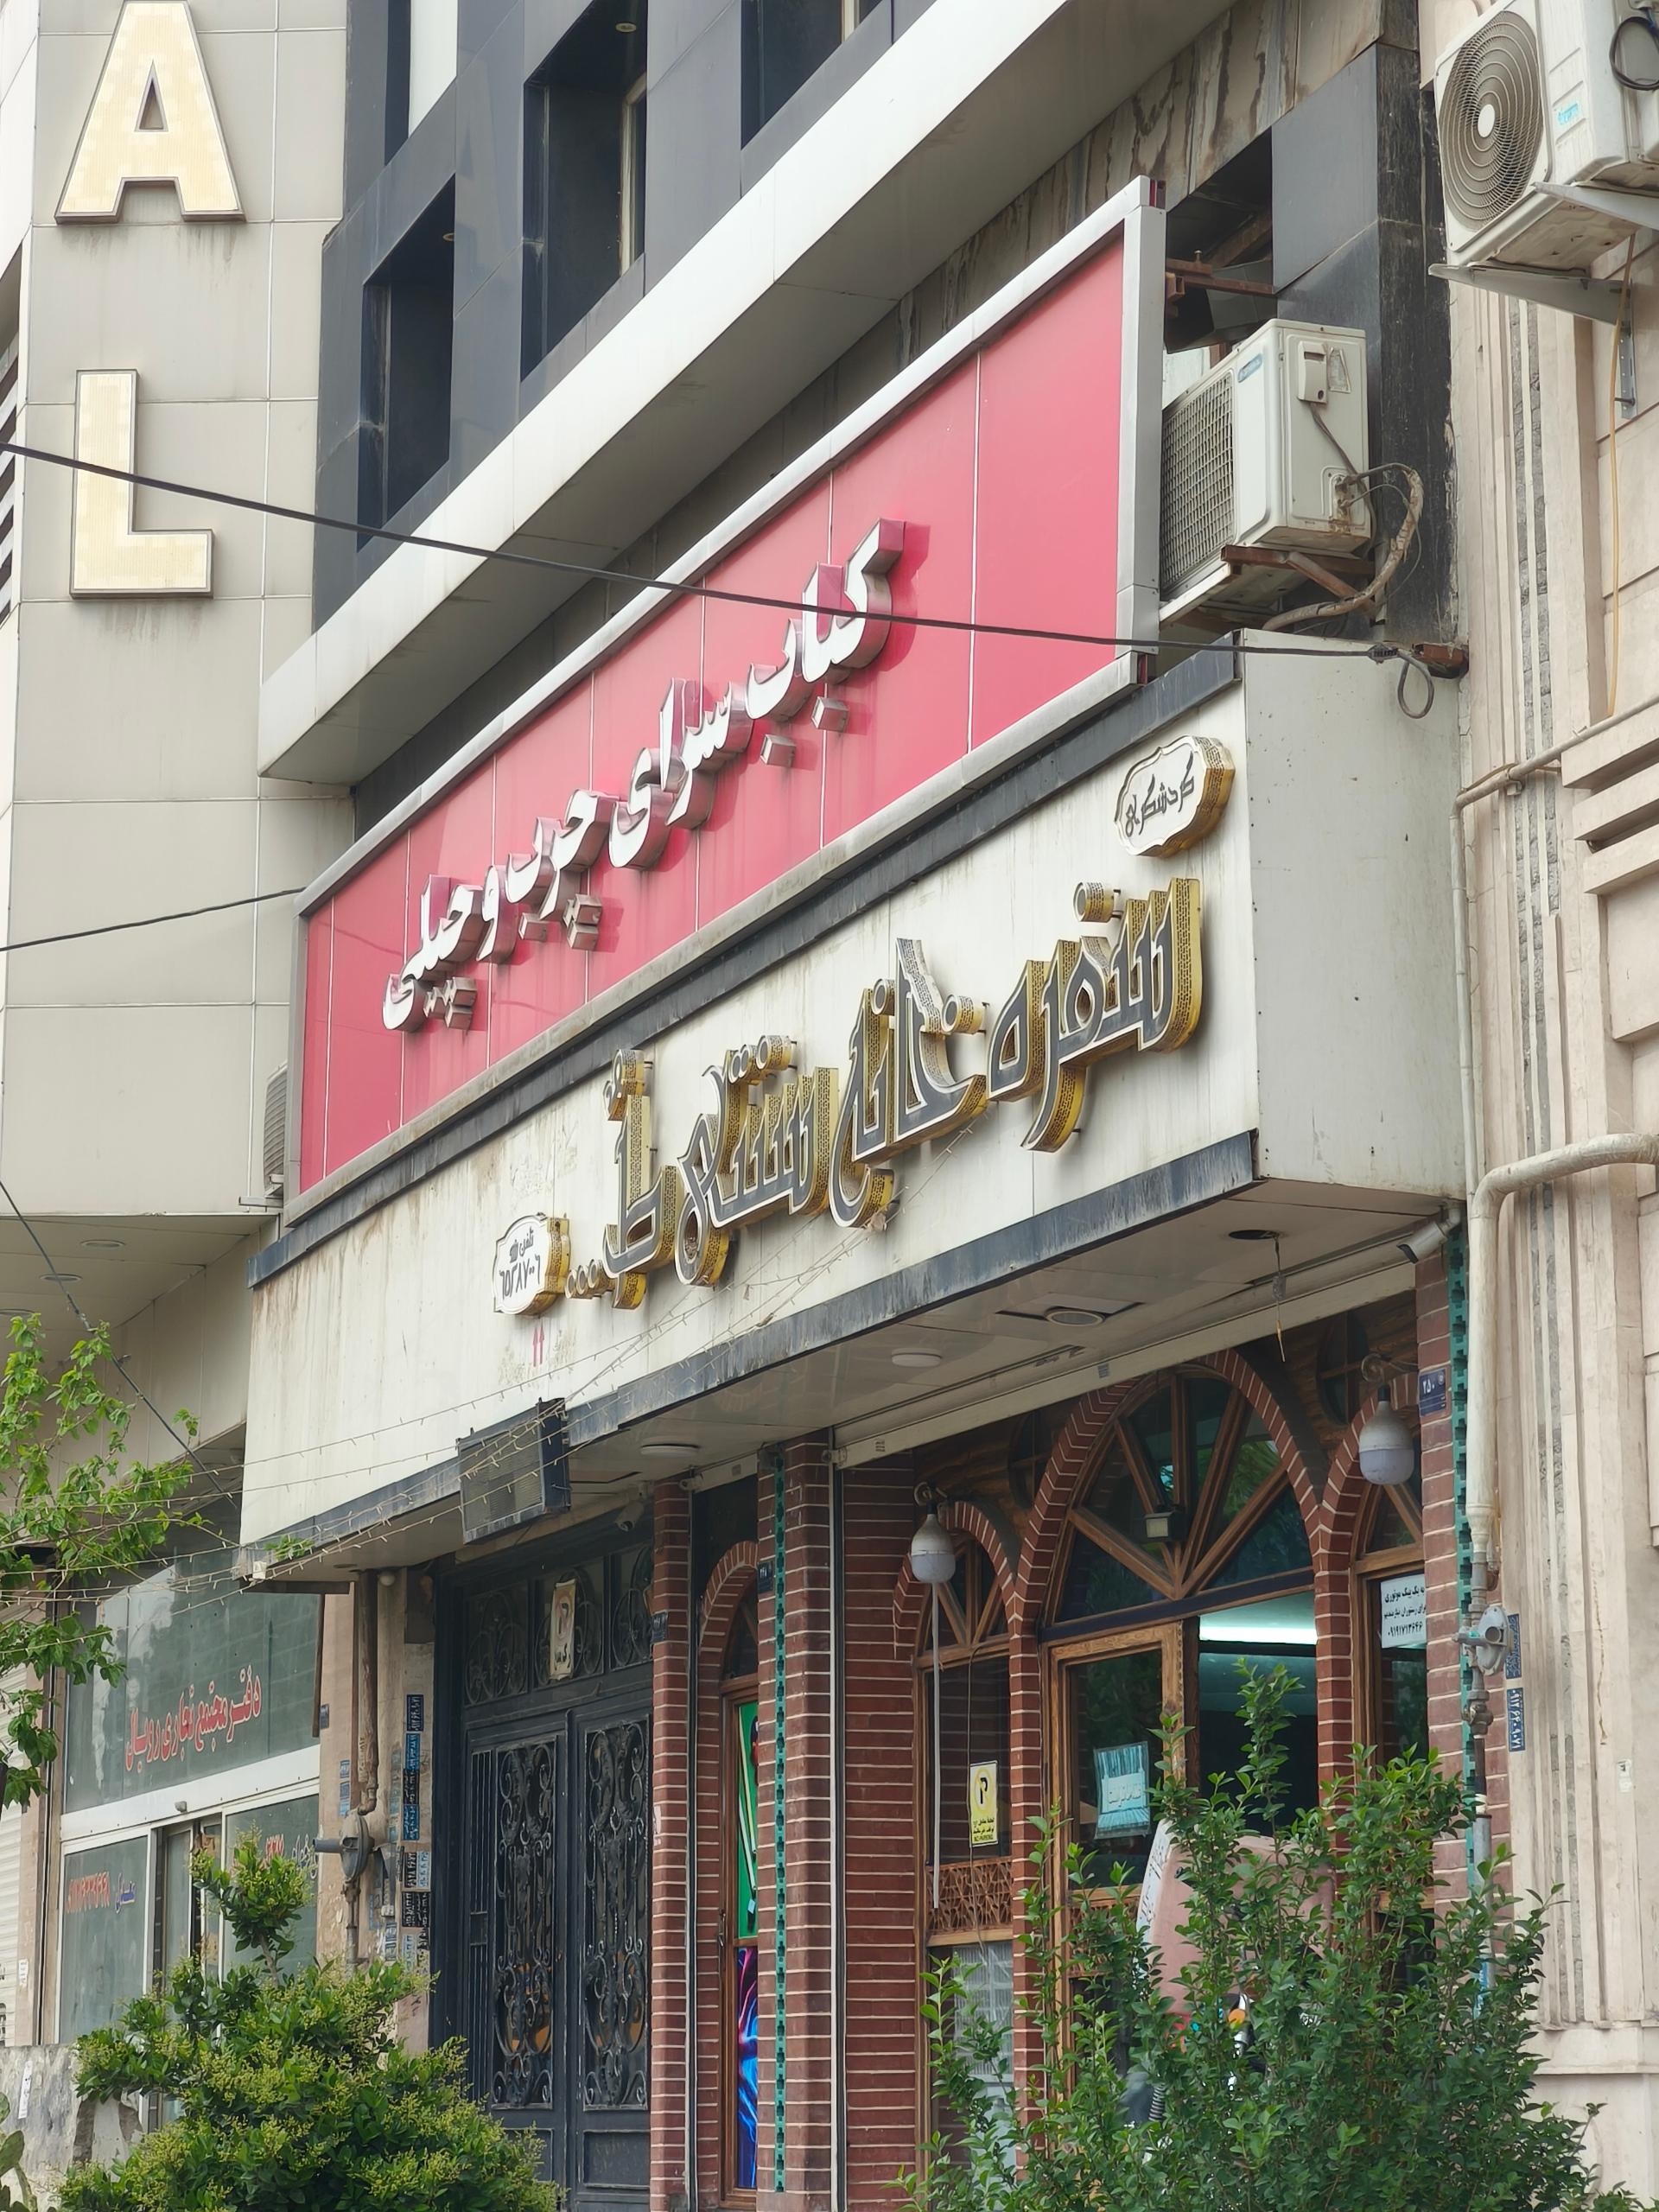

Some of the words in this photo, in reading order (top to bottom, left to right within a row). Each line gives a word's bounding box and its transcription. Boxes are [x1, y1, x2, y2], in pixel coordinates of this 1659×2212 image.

[746, 518, 906, 766] کباب
[608, 677, 754, 868] سرای
[476, 865, 518, 963] و
[505, 789, 610, 949] چرب
[382, 874, 483, 1030] چیلی
[988, 878, 1202, 1153] سفره
[125, 1707, 161, 1773] رویال
[162, 1684, 194, 1762] تجاری
[195, 1681, 227, 1752] مجتمع
[226, 1664, 261, 1743] دفتر
